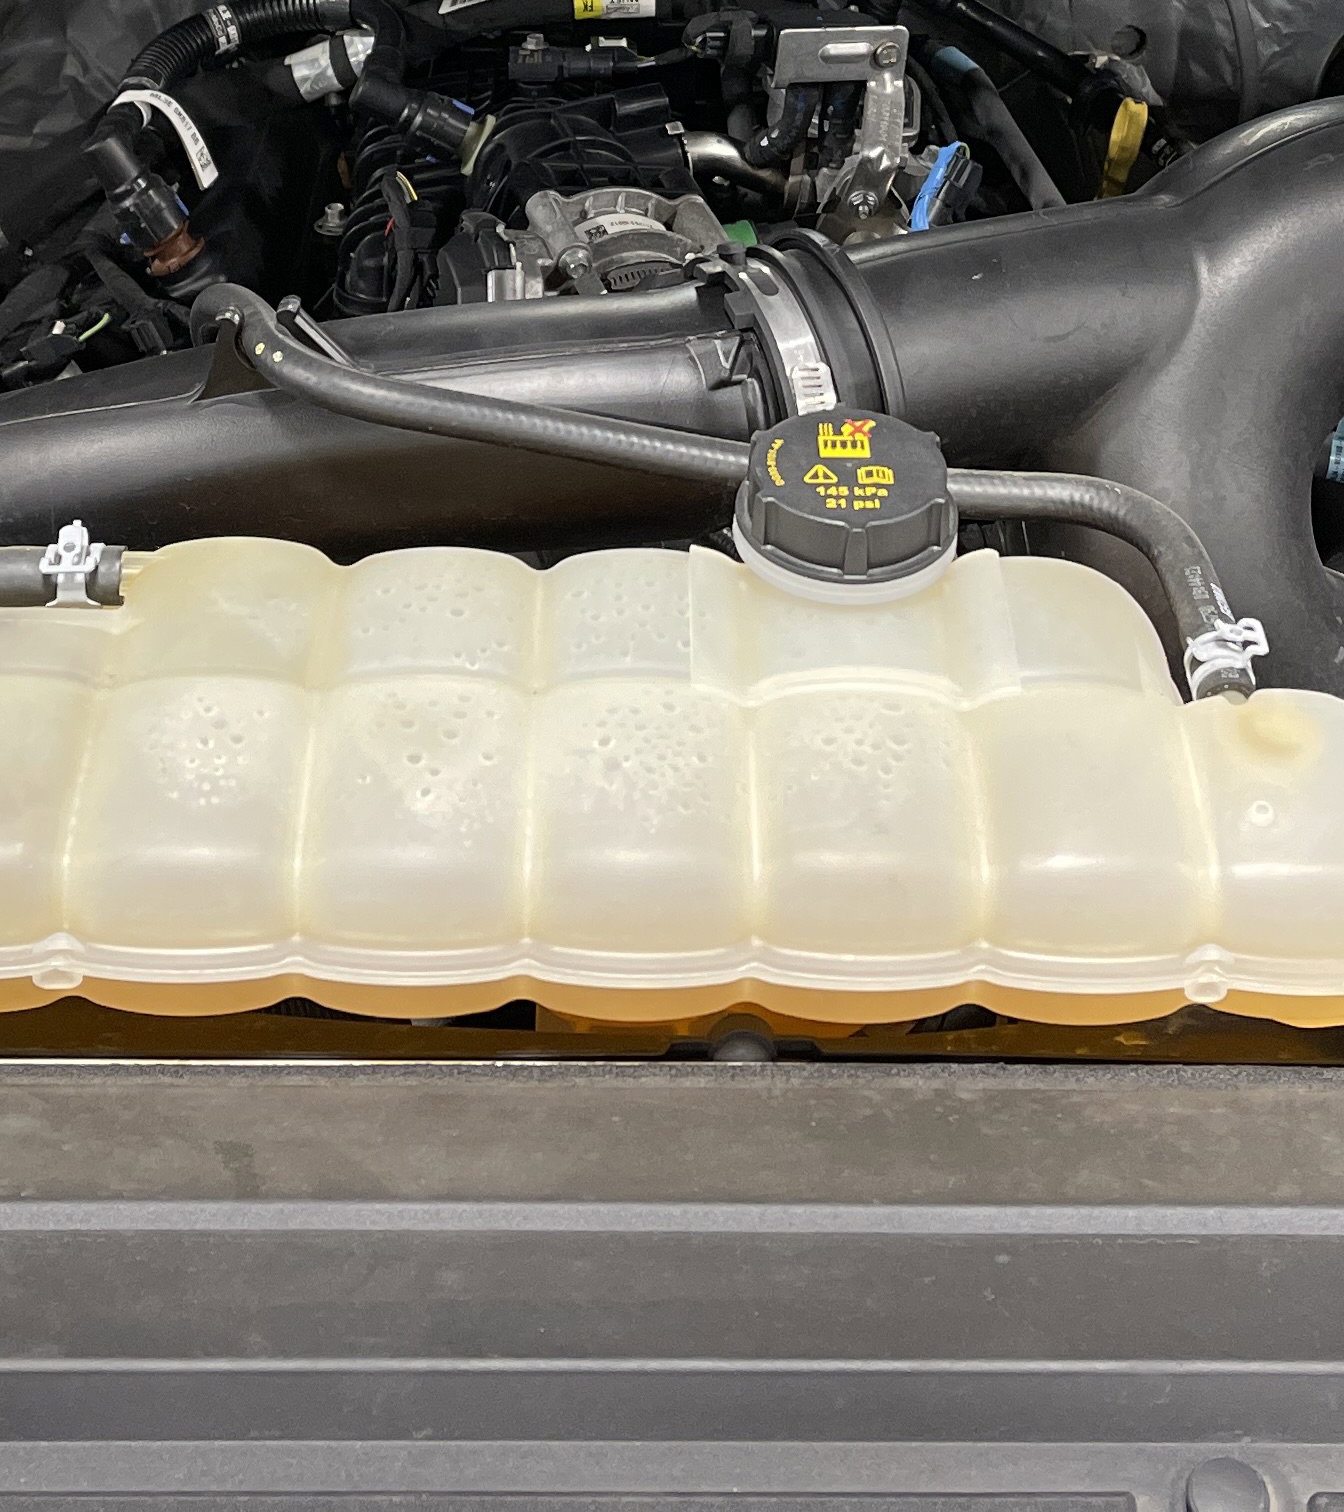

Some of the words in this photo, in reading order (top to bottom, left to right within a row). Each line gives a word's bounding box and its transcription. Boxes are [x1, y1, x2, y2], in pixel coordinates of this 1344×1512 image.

[815, 486, 849, 497] 145
[853, 486, 889, 497] kPa
[825, 498, 847, 509] 21
[852, 498, 881, 511] psi
